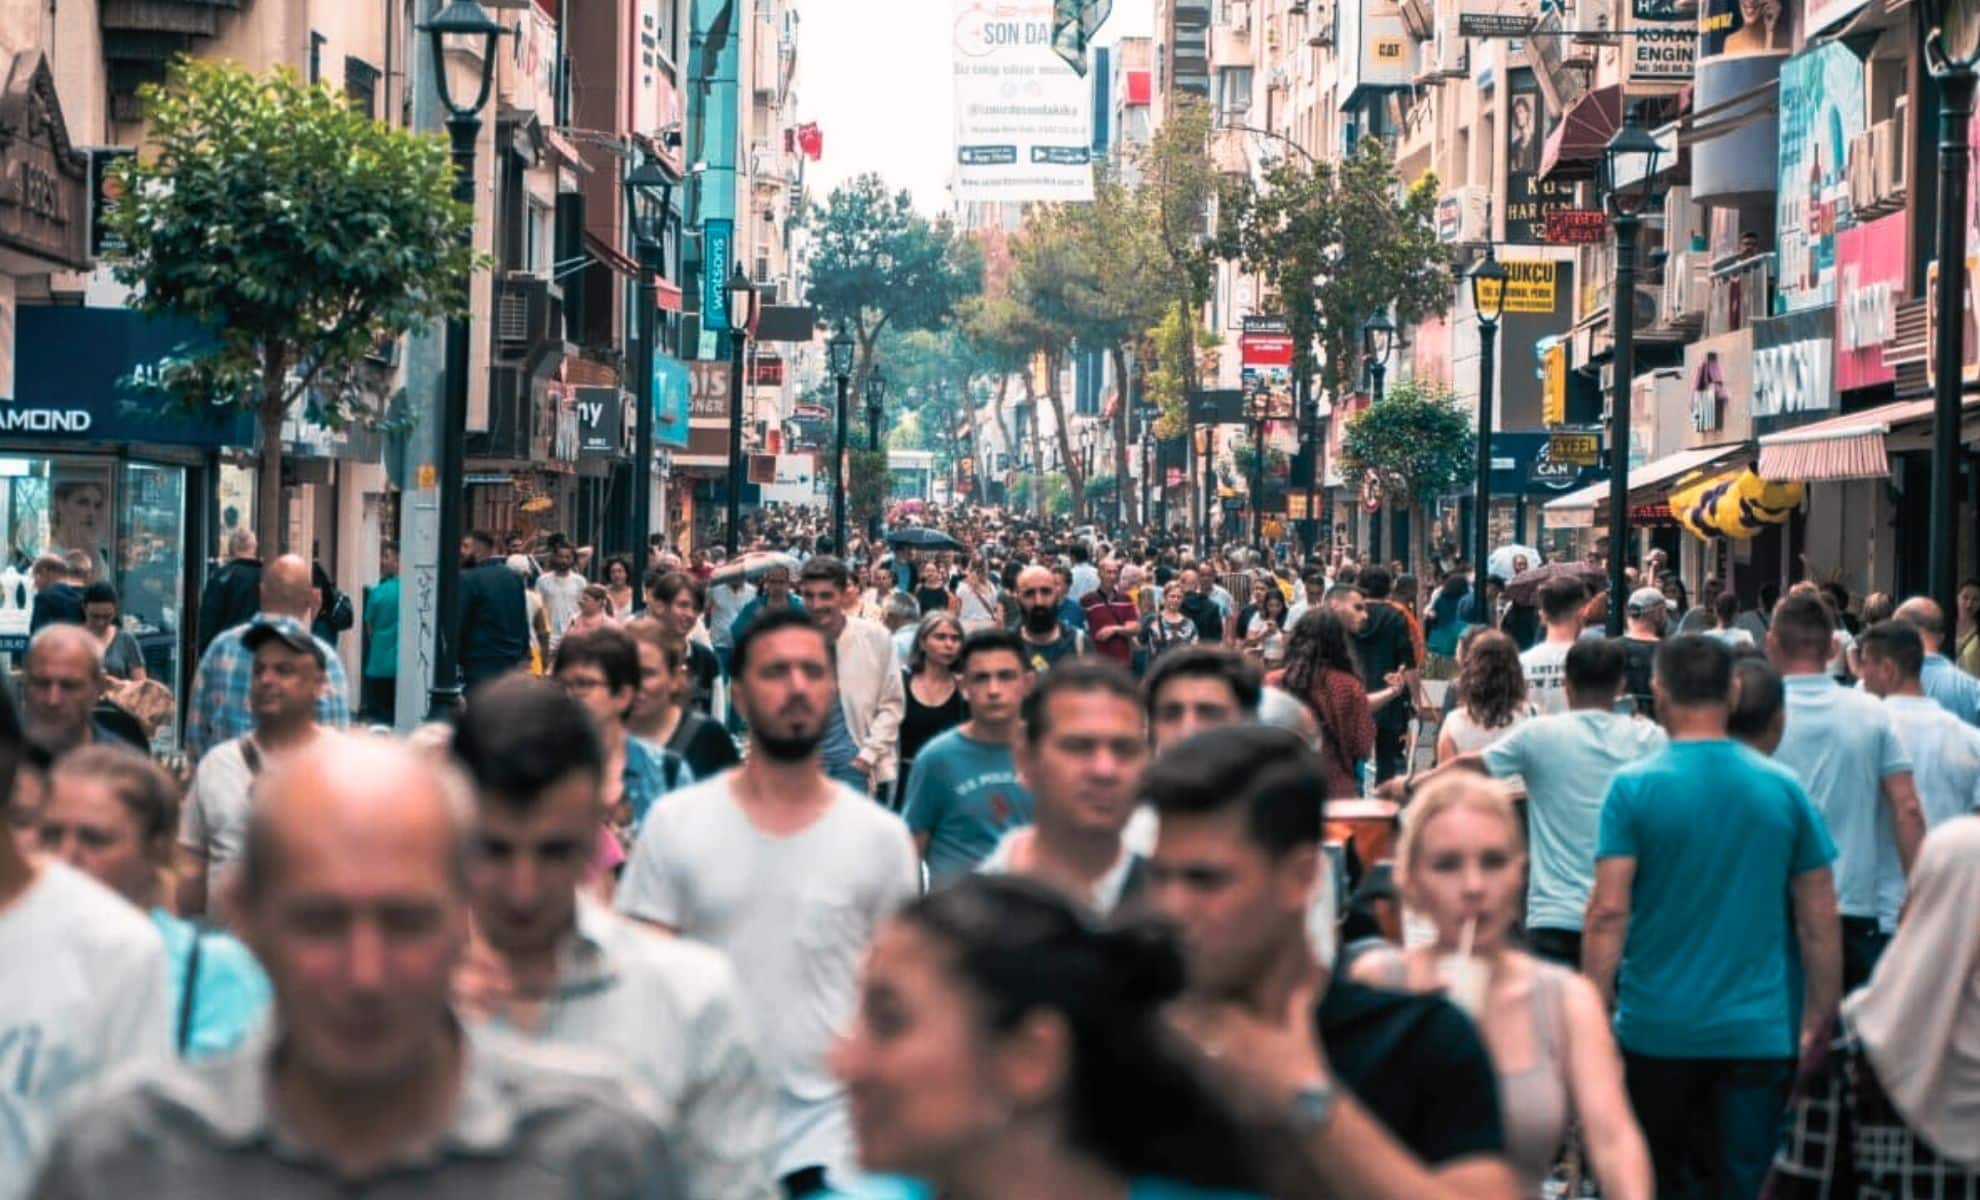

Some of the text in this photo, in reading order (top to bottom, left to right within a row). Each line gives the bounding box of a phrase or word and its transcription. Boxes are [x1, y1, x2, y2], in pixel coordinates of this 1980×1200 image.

[984, 22, 1048, 45] SON DA
[1637, 44, 1693, 61] ENGİN
[711, 238, 725, 310] watsons
